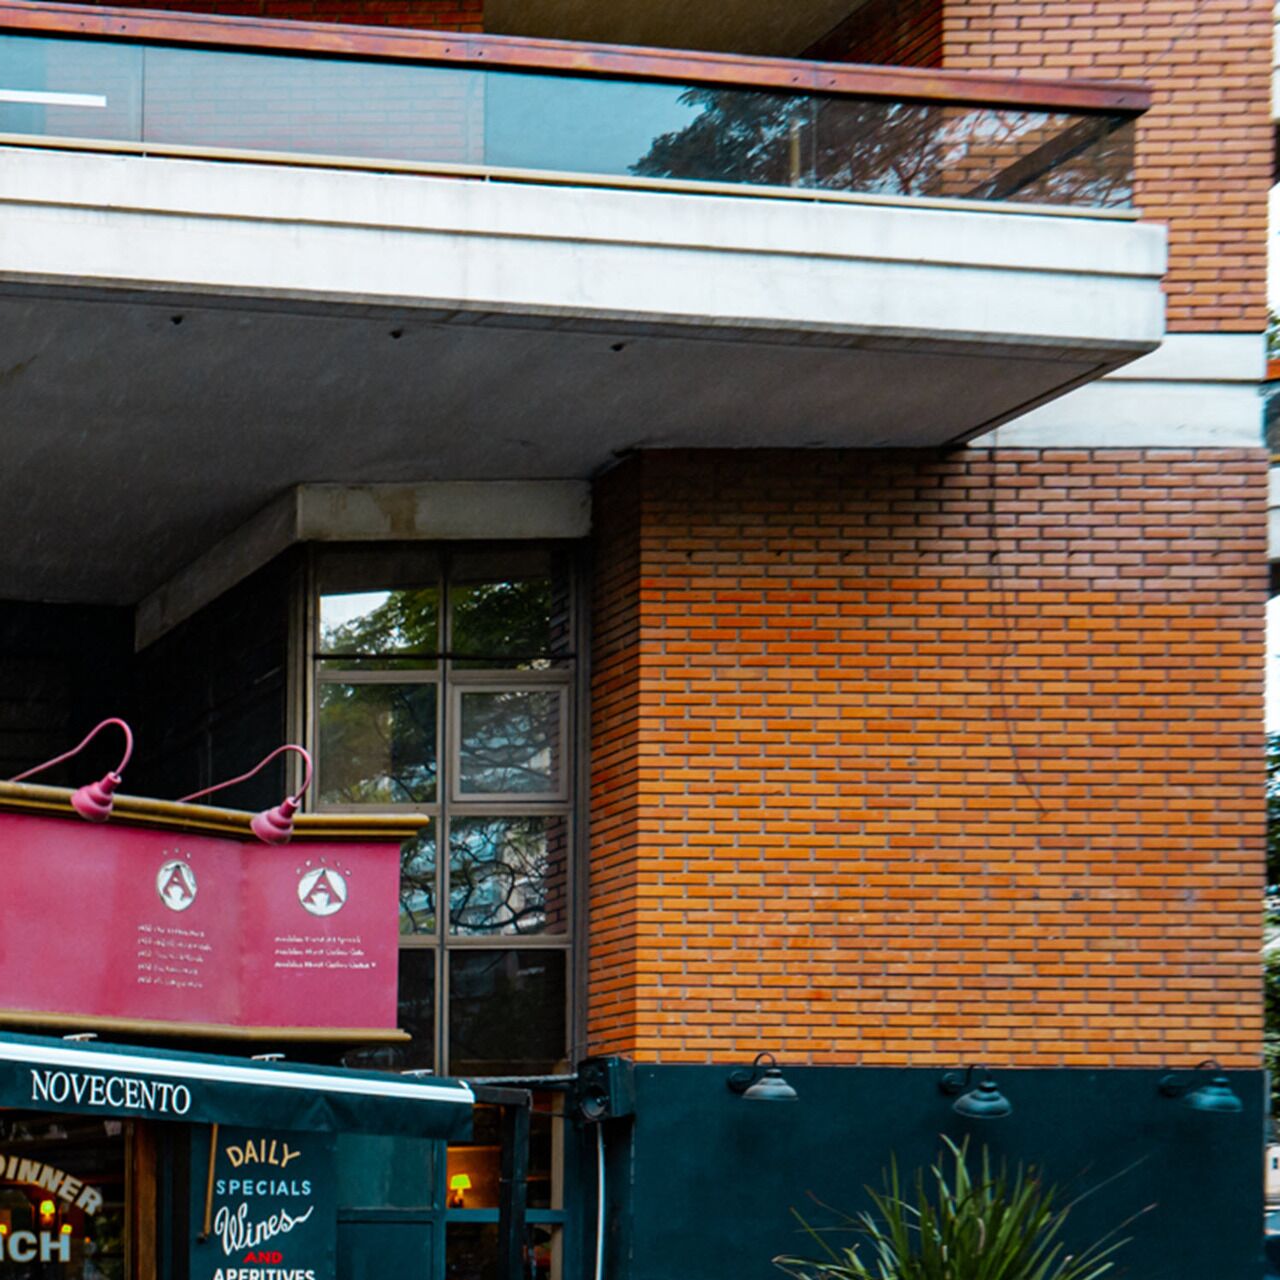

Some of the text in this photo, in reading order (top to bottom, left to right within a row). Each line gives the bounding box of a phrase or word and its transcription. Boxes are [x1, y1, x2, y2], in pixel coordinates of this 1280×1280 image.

[30, 1069, 192, 1115] NOVECENTO
[225, 1138, 302, 1169] DAILY
[215, 1179, 313, 1196] SPECIALS
[214, 1202, 315, 1257] Wines
[242, 1250, 284, 1265] AND
